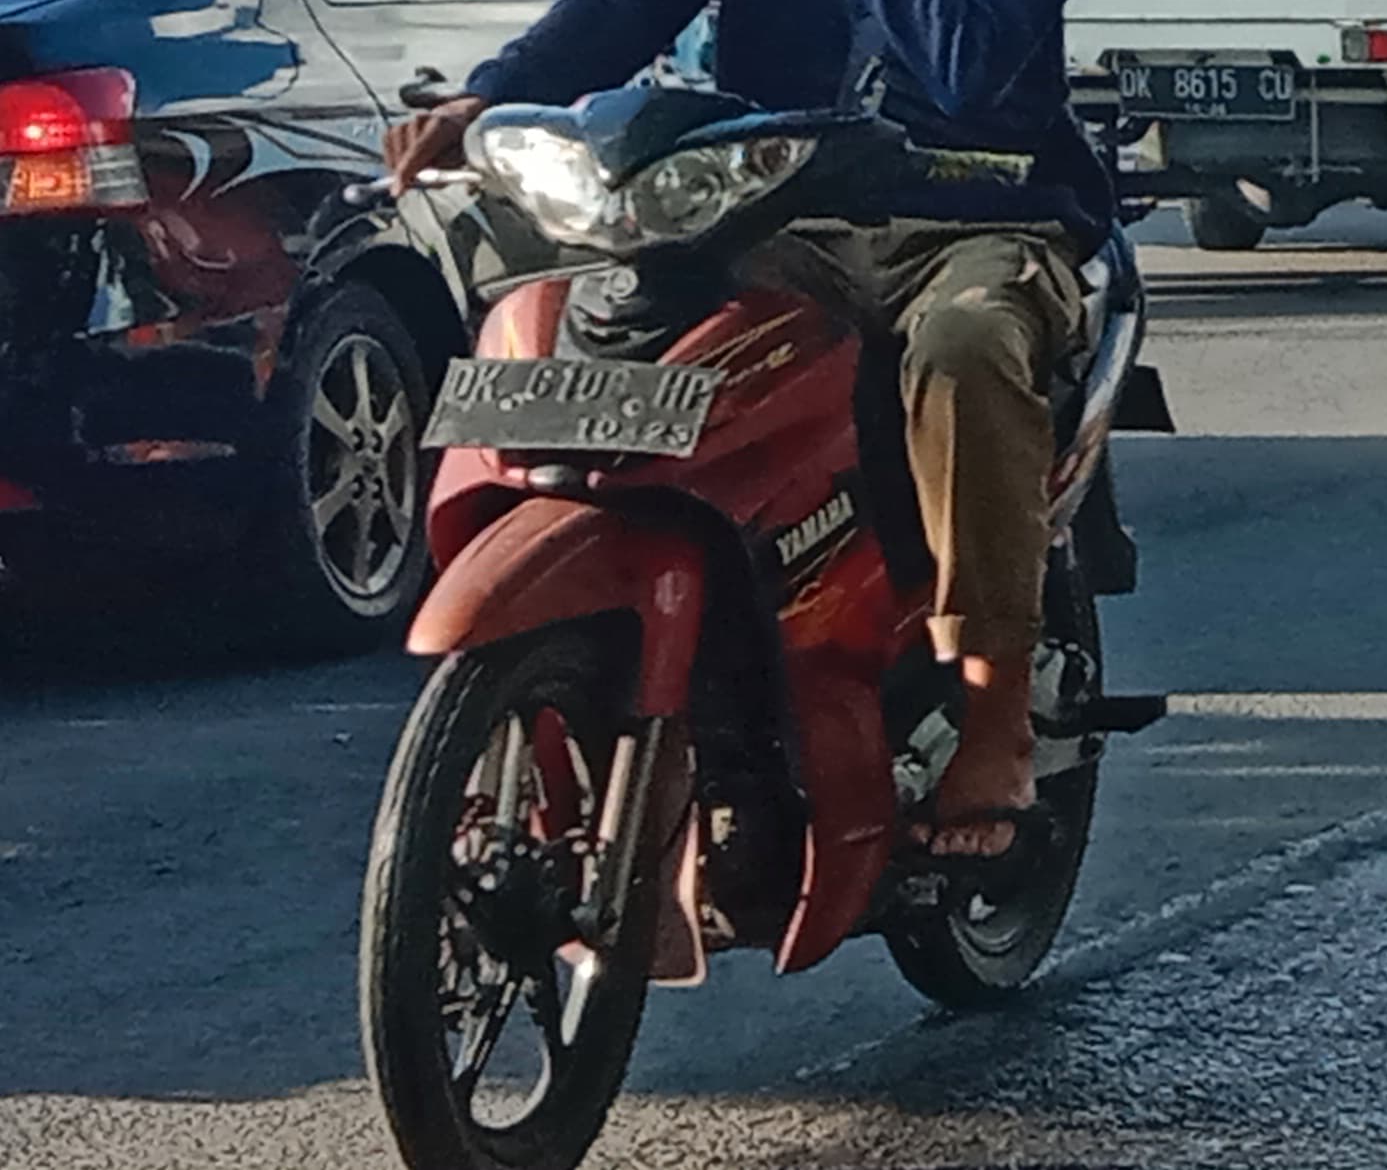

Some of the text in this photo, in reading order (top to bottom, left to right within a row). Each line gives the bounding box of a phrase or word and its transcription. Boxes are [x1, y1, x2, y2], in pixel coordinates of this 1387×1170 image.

[1120, 67, 1293, 100] DK 8615 CU
[776, 491, 855, 565] YAMAHA
